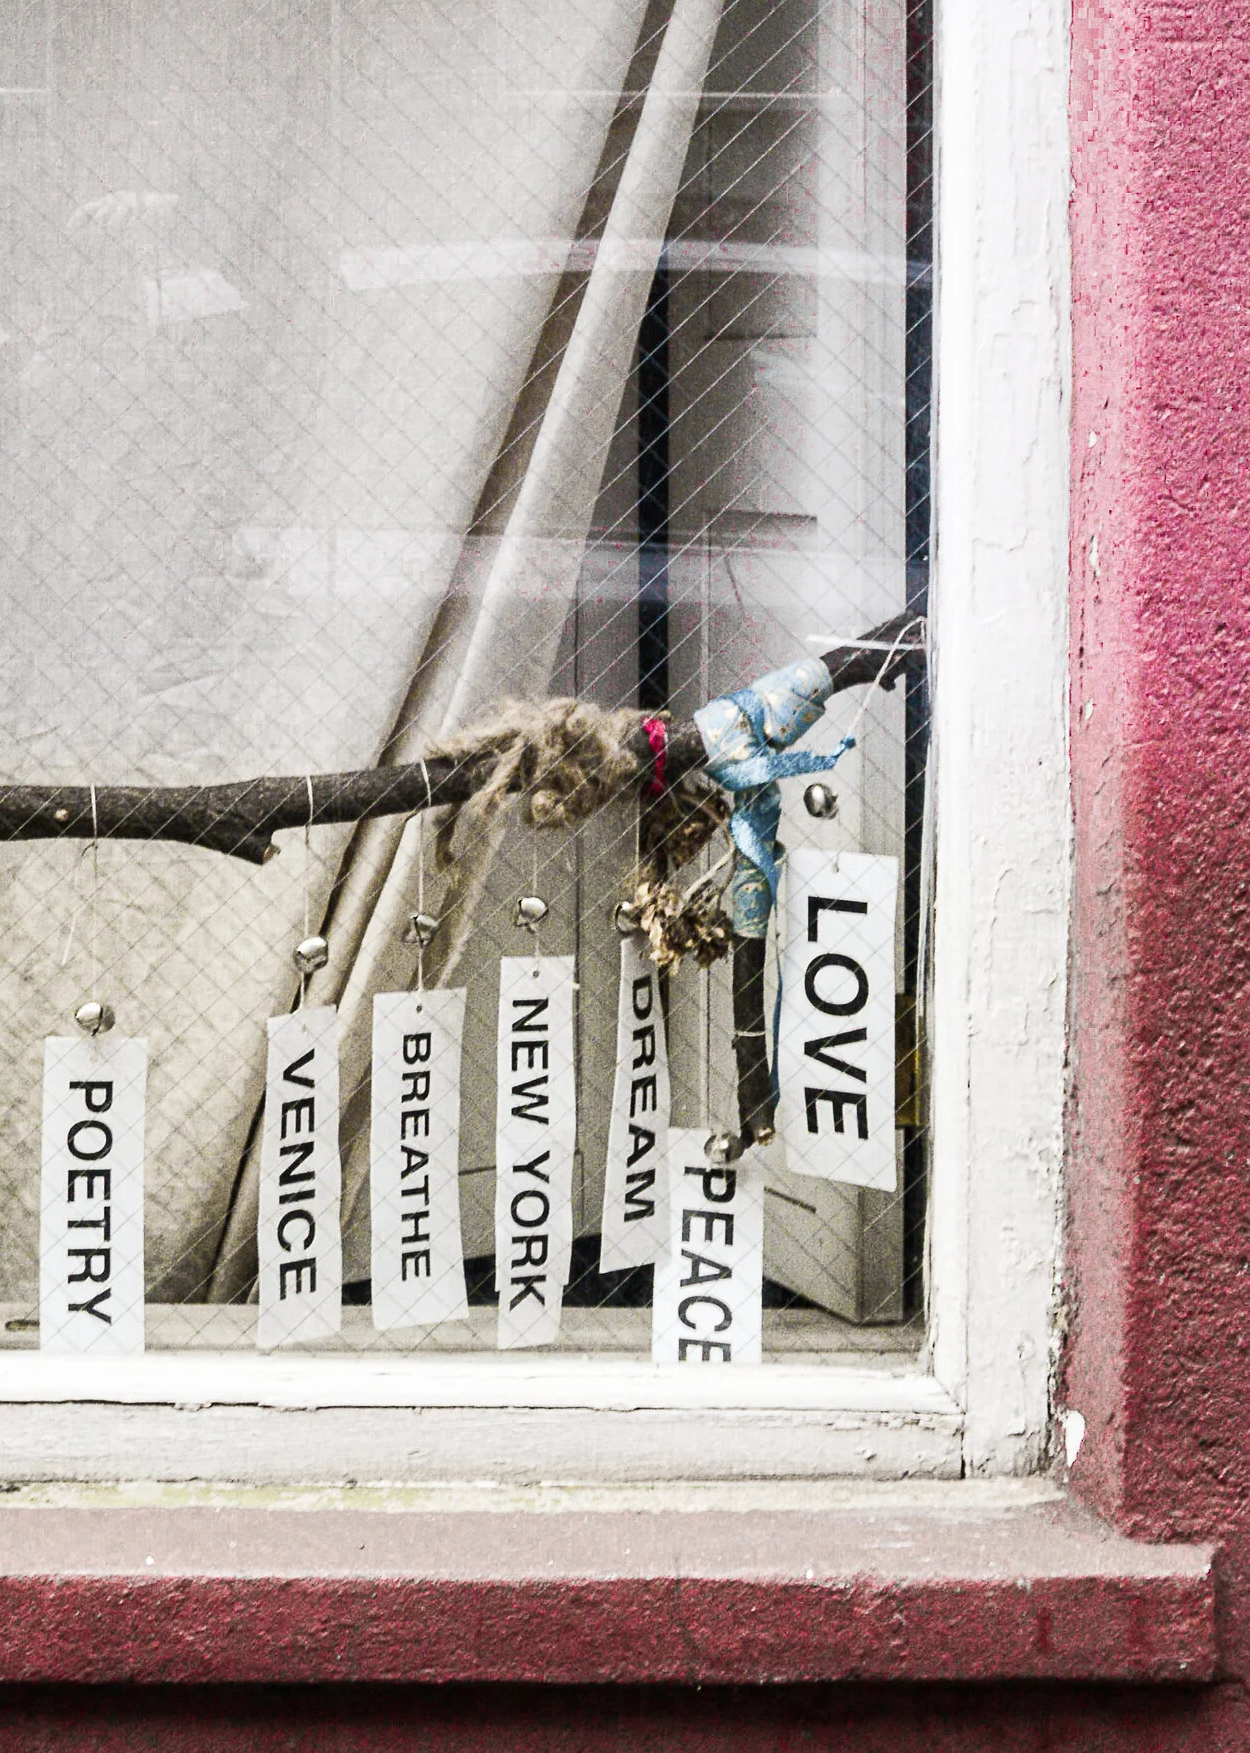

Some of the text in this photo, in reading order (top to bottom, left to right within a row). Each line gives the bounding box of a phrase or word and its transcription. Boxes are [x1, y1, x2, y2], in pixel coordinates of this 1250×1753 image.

[623, 975, 657, 1223] DREAM
[804, 896, 868, 1140] LOVE
[68, 1081, 113, 1323] POETRY
[278, 1049, 316, 1300] VENICE
[401, 1033, 431, 1281] BREATHE
[510, 998, 550, 1310] NEW YORK
[679, 1167, 736, 1361] PEACE
